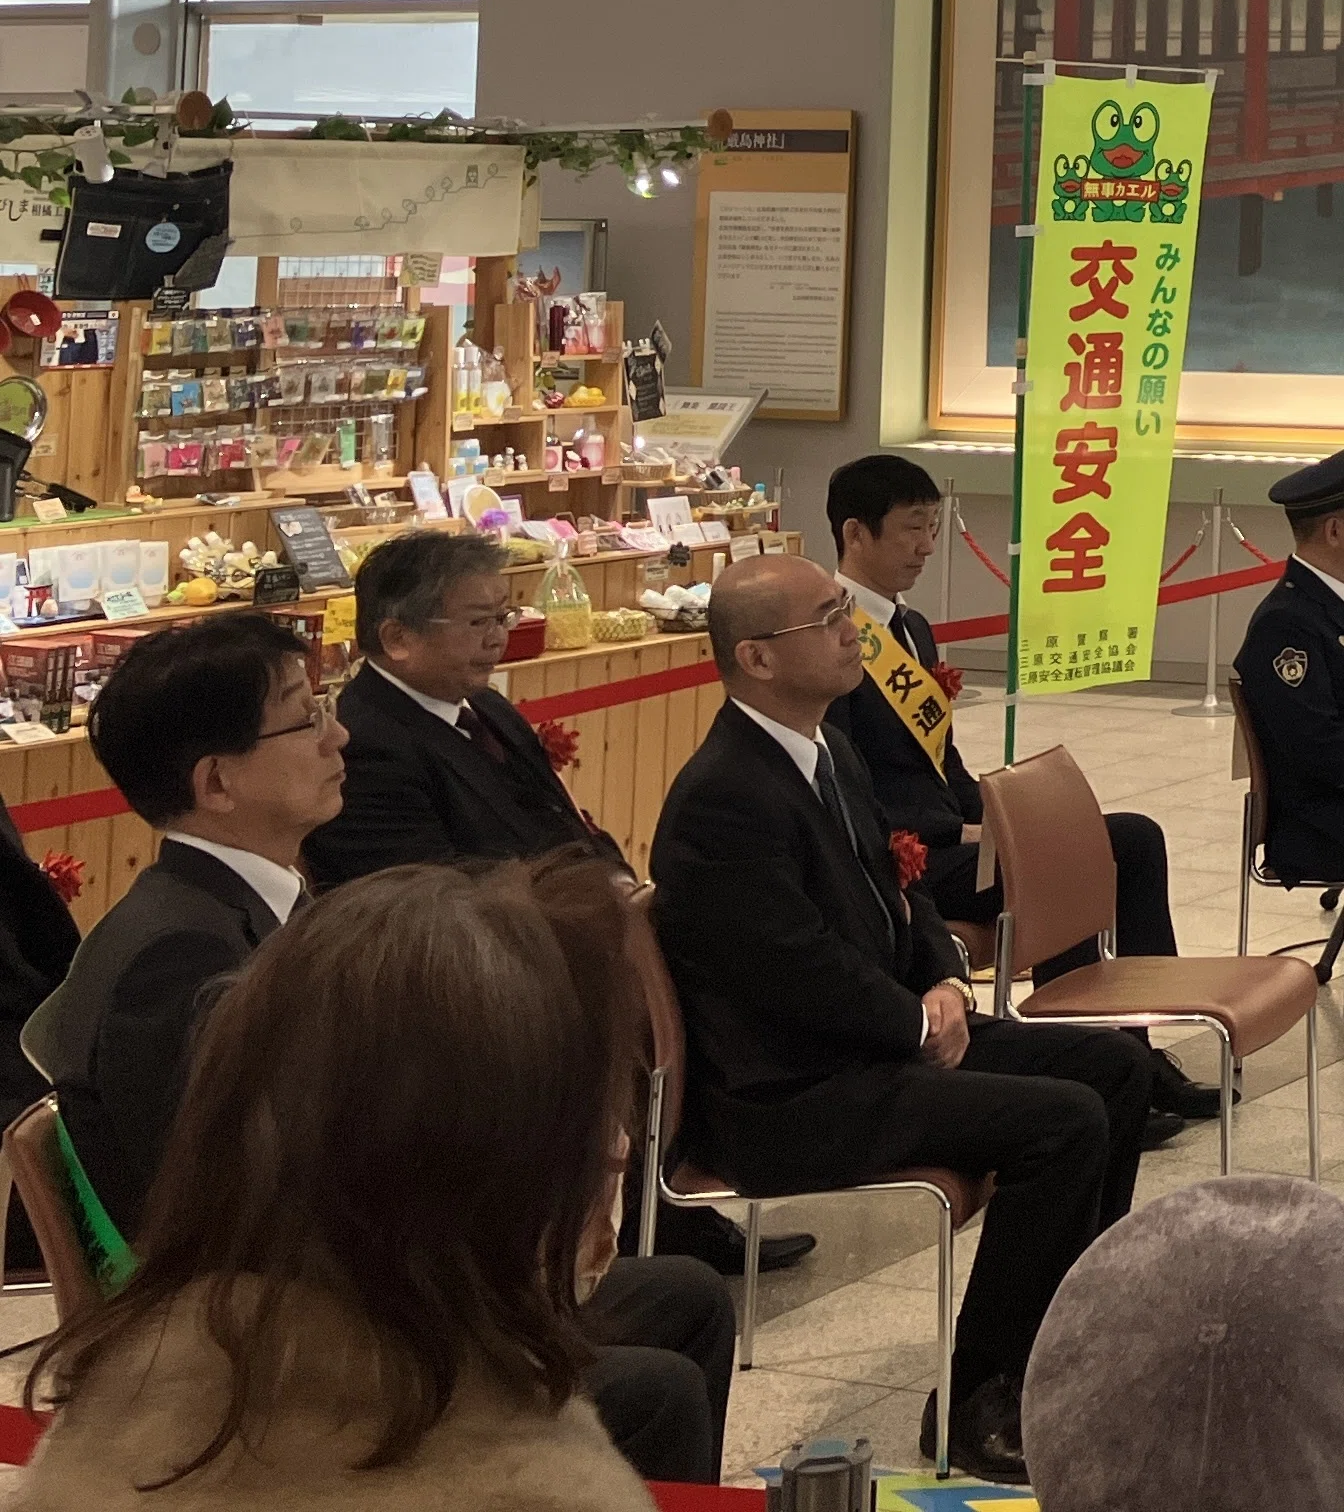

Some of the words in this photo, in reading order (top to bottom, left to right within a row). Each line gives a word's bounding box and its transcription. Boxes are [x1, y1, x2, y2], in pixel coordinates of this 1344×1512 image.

[1083, 181, 1158, 199] 無事カエル
[1135, 241, 1182, 437] みんなの願い
[1041, 238, 1138, 594] 交通安全
[885, 662, 946, 738] 交通
